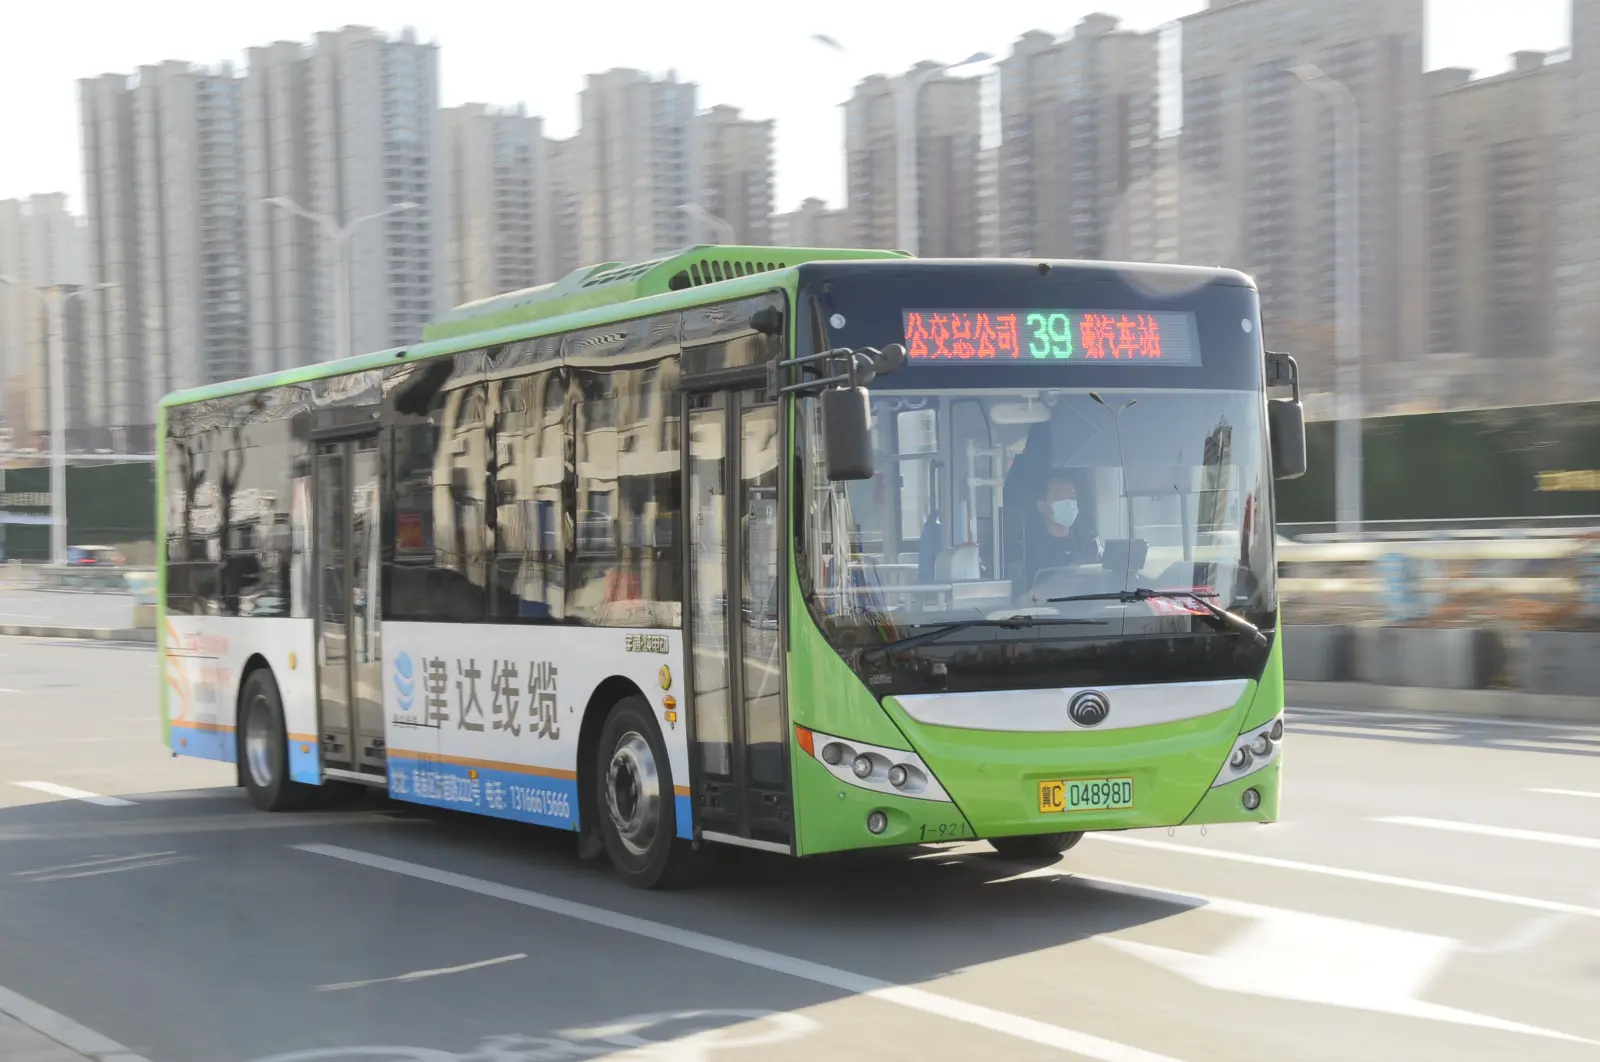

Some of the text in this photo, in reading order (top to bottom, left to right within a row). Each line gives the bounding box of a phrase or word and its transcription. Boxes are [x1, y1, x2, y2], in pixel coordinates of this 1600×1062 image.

[904, 312, 1020, 360] 公交总公司
[1026, 312, 1074, 359] 39
[421, 656, 560, 740] 津达线缆
[919, 823, 967, 841] 1-921
